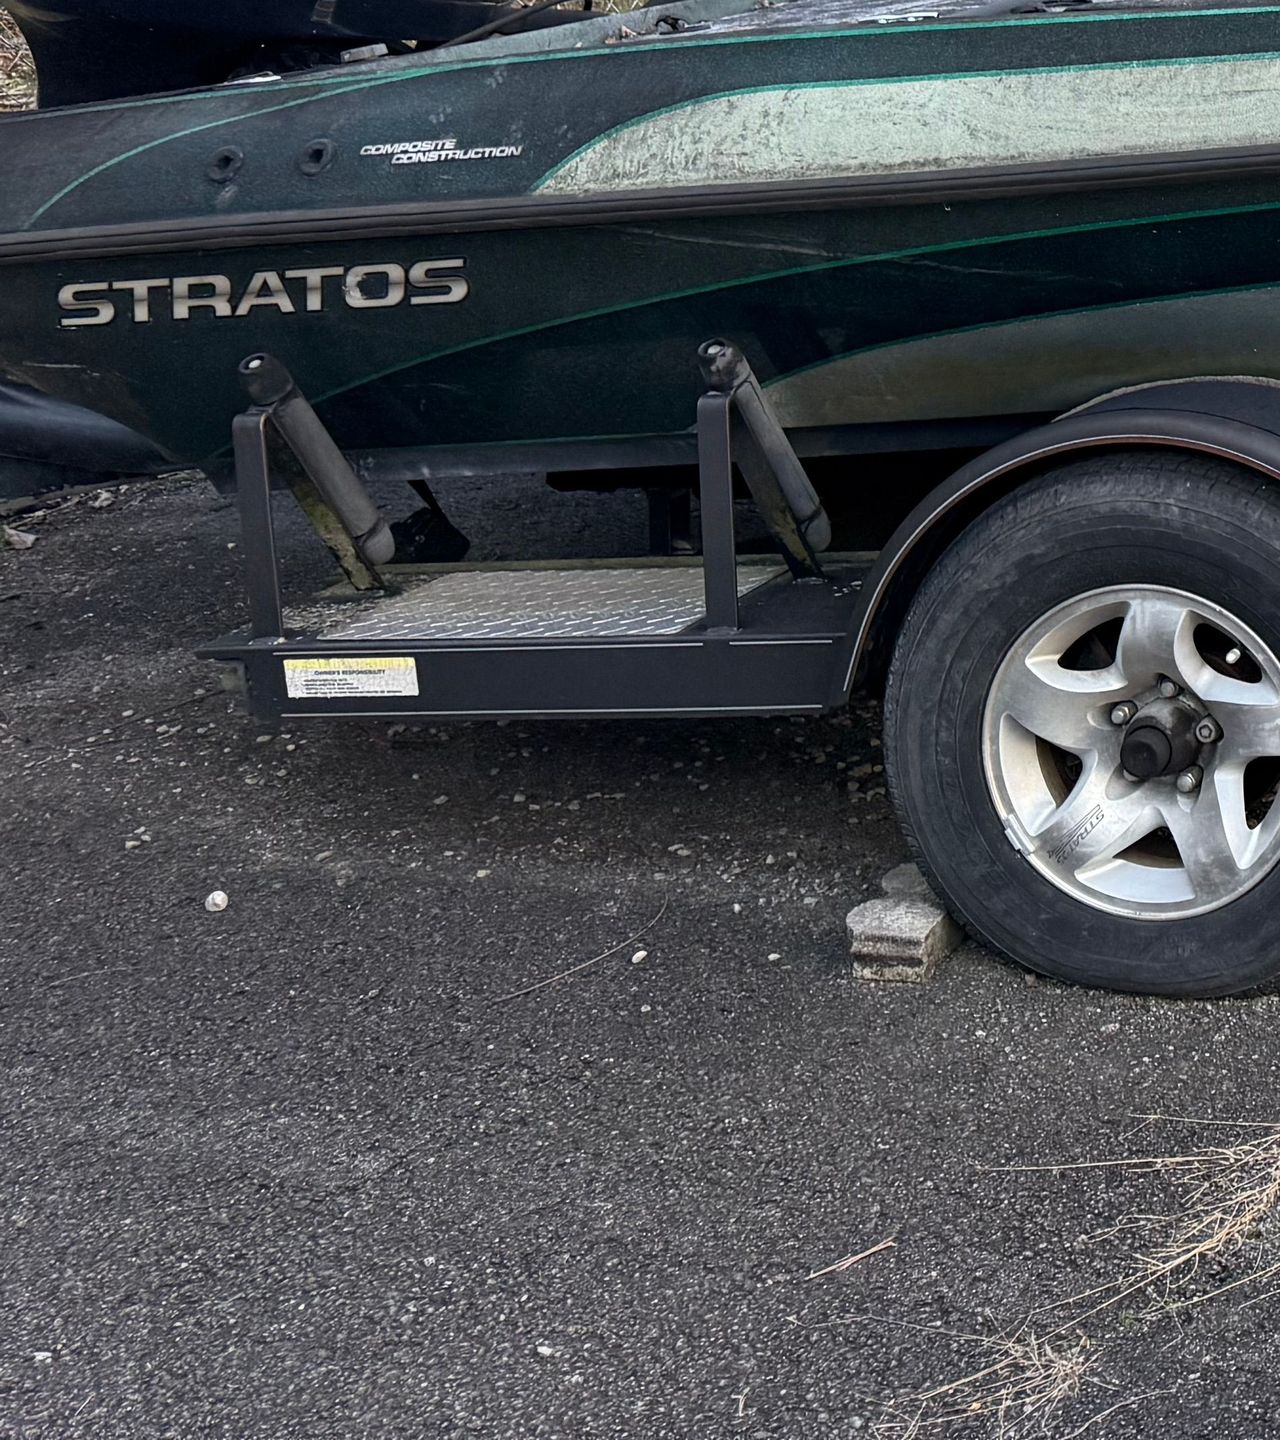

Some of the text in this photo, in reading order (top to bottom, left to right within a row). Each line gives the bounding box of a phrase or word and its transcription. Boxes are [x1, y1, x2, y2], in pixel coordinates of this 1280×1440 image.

[360, 139, 457, 155] COMPOSITE
[391, 145, 524, 164] CONSTRUCTION
[57, 258, 470, 327] STRATOS
